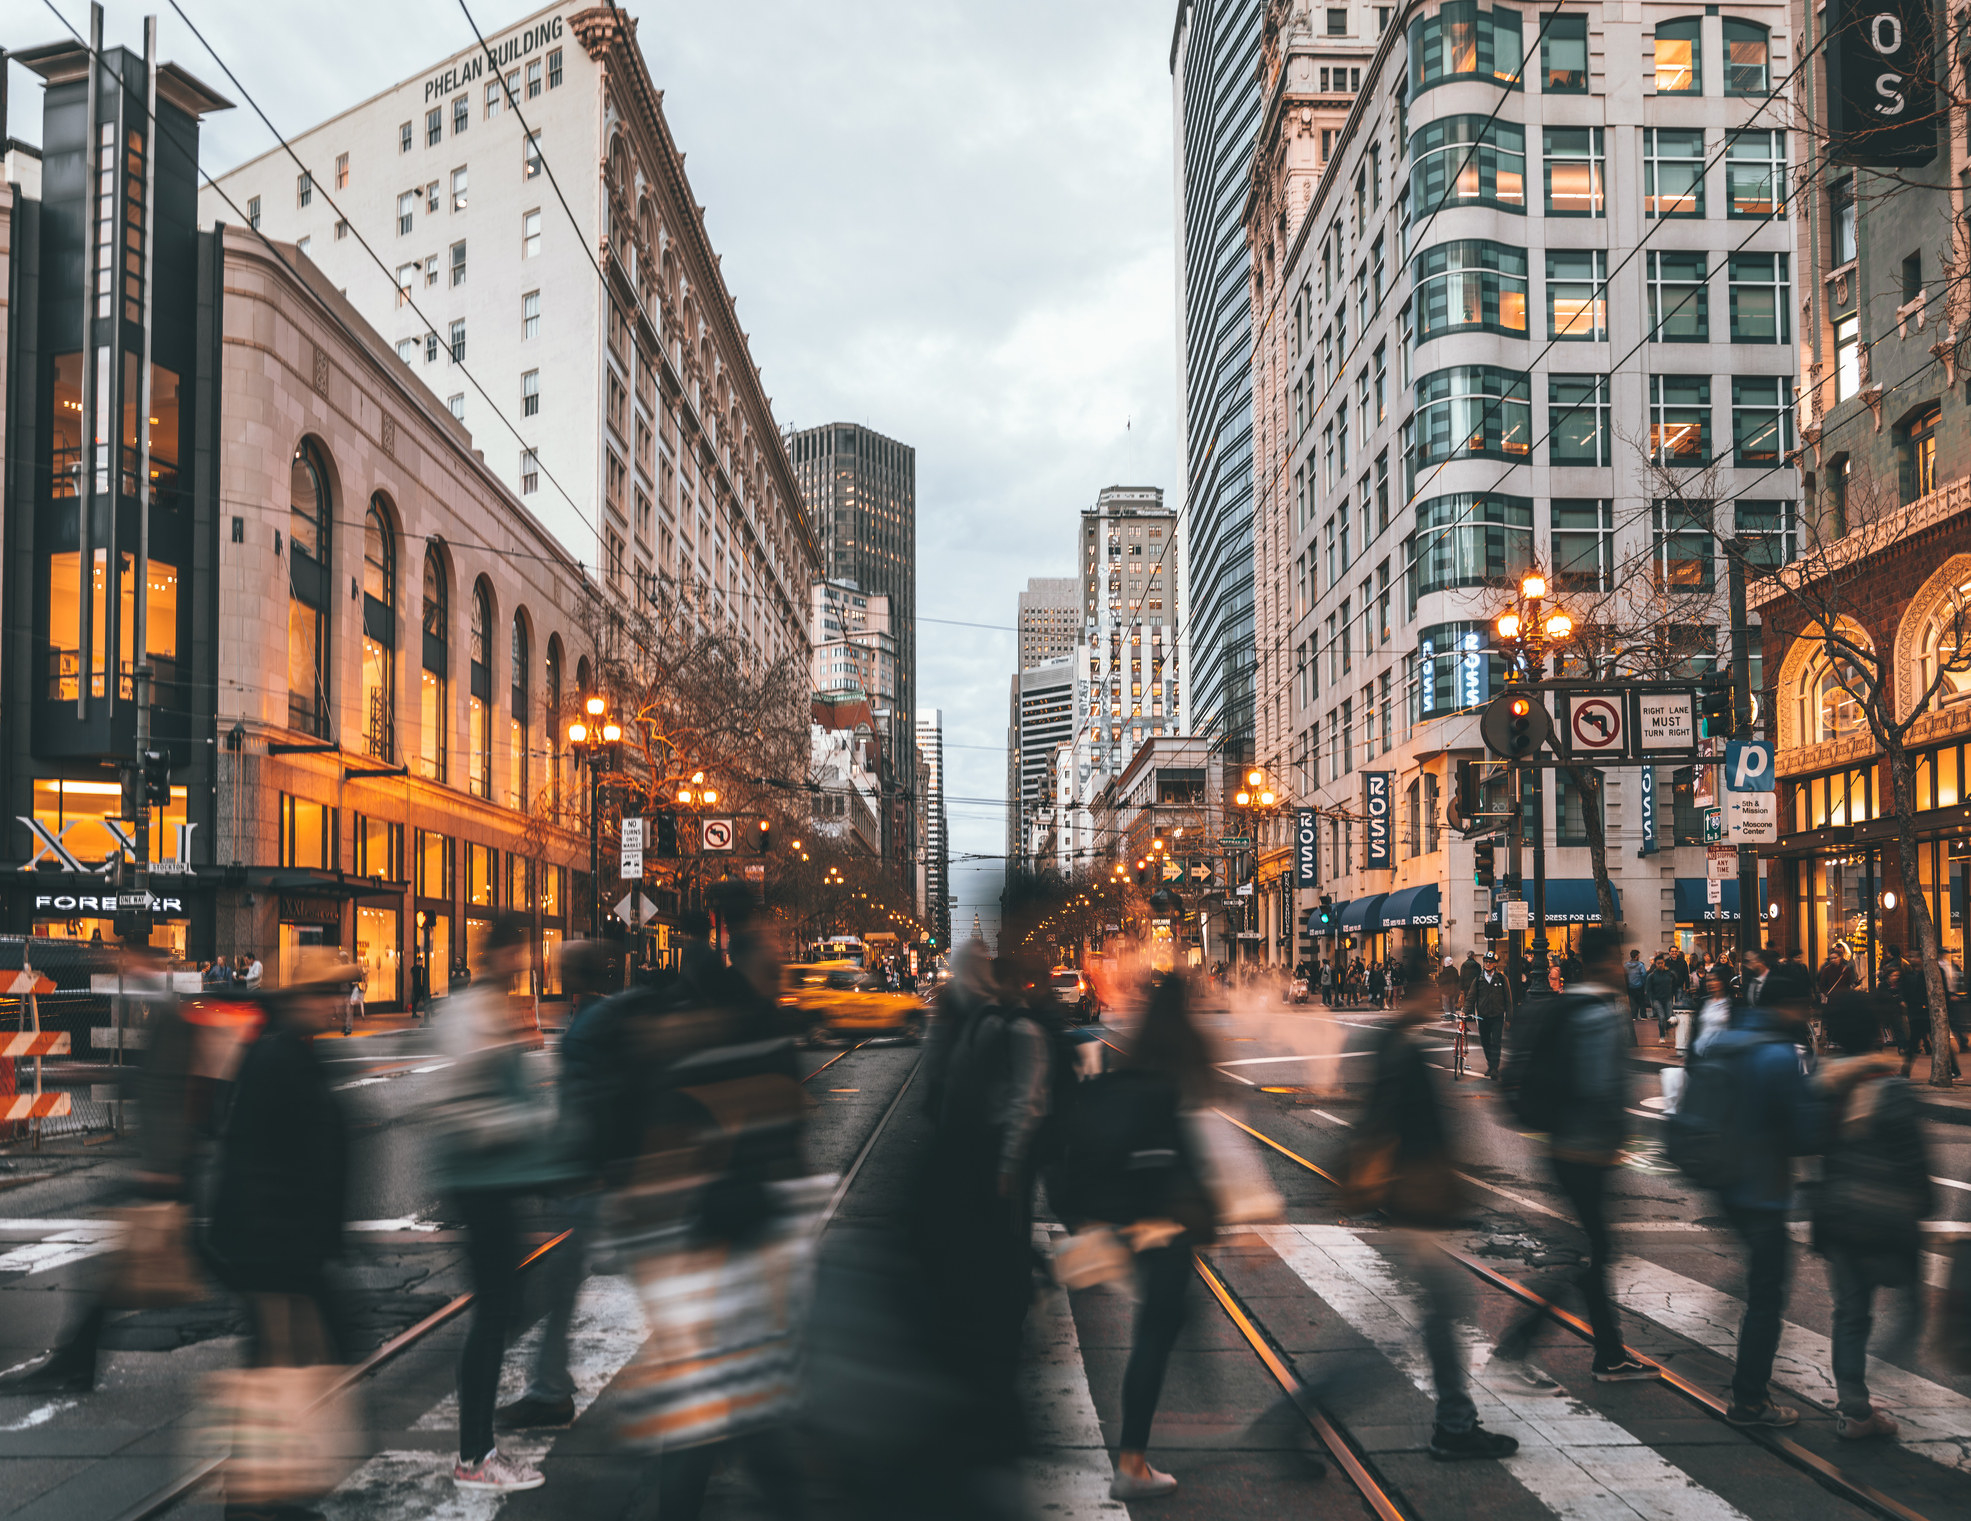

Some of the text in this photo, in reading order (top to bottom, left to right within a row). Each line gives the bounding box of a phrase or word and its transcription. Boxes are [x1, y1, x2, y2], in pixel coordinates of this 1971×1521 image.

[425, 15, 562, 104] PHELAN BUILDING
[1422, 641, 1433, 712] ROSS
[1464, 634, 1480, 706] ROSS
[1652, 717, 1680, 727] MUST
[1369, 777, 1386, 858] ROSS
[1300, 812, 1314, 879] ROSS
[152, 864, 184, 872] STOCKTON
[36, 896, 182, 912] FORER
[120, 896, 144, 905] ONE WAY
[1412, 915, 1439, 924] ROSS
